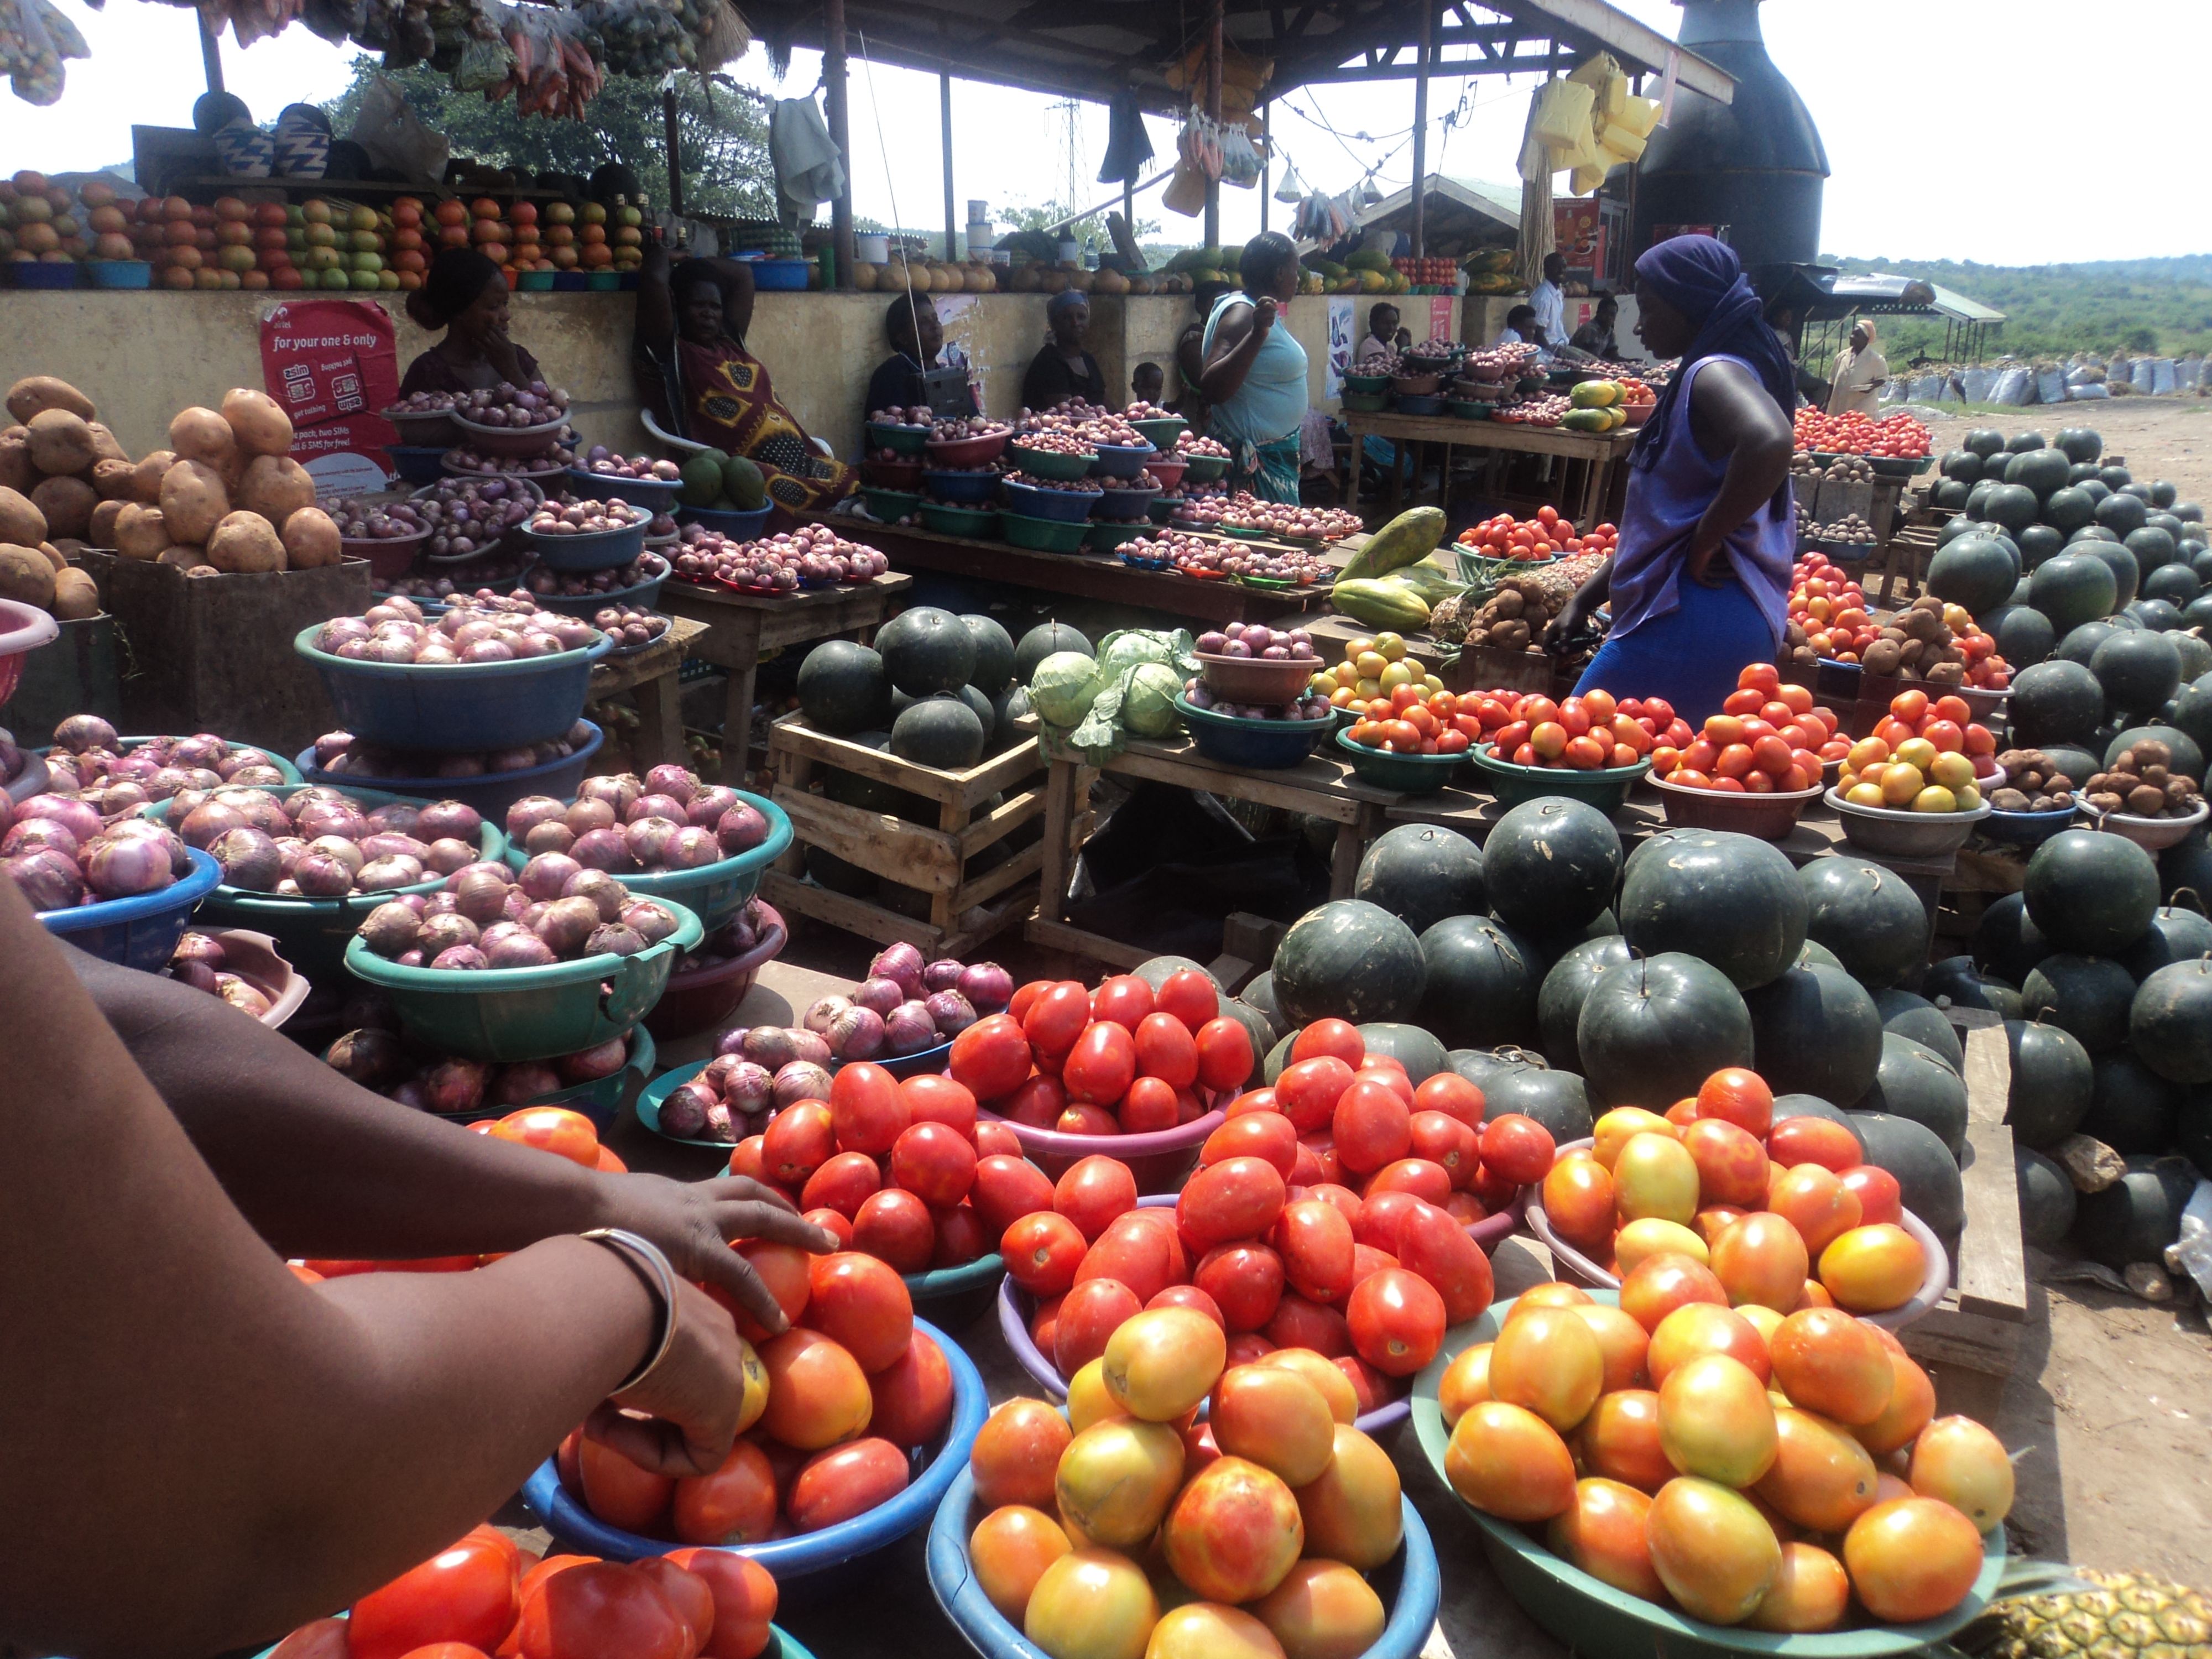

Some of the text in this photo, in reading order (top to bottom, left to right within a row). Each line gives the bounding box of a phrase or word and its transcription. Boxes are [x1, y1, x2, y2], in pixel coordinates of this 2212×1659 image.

[273, 333, 377, 352] for your one & only
[294, 404, 326, 419] get talking
[299, 429, 317, 440] pack,
[333, 426, 349, 435] SIMs
[308, 440, 322, 449] SMS
[324, 440, 333, 450] for
[334, 438, 350, 449] free!
